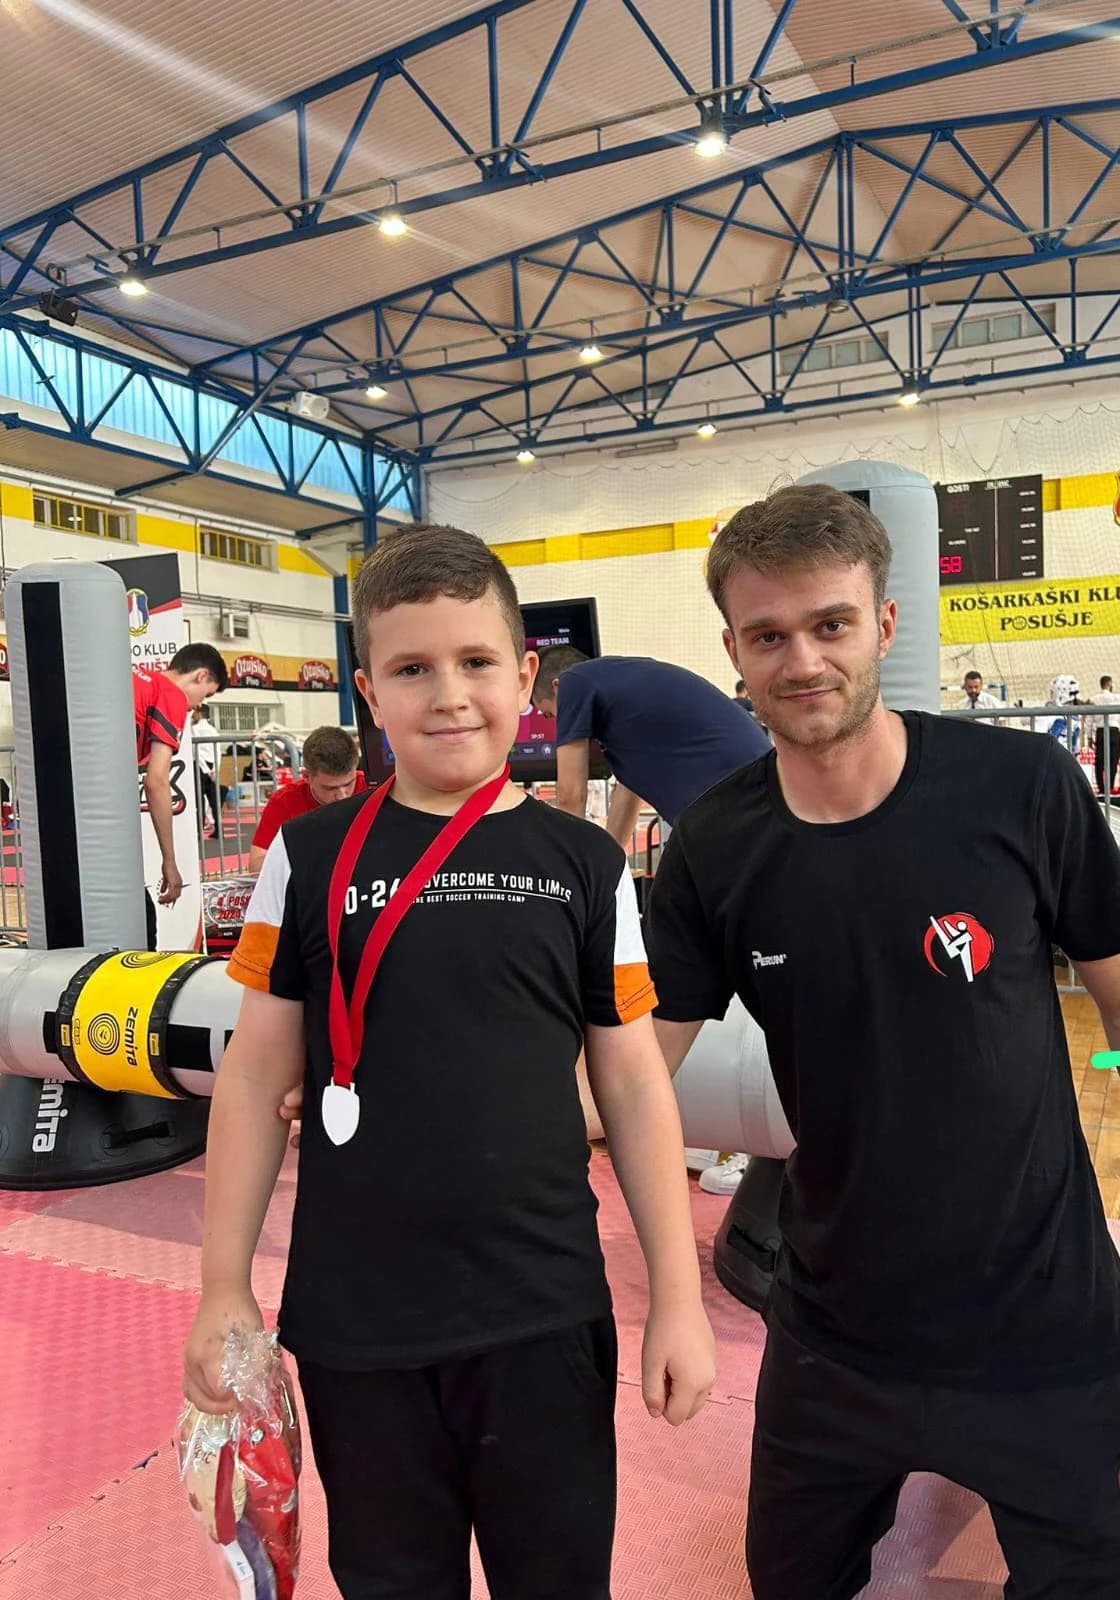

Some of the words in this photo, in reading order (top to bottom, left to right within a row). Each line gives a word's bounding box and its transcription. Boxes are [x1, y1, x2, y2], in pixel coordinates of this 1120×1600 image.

[950, 586, 1081, 612] KOŠARKAŠKI
[1001, 608, 1093, 631] POSUŠJE
[144, 642, 177, 656] KLUB
[500, 873, 533, 891] YOUR
[474, 892, 505, 901] TRAINING
